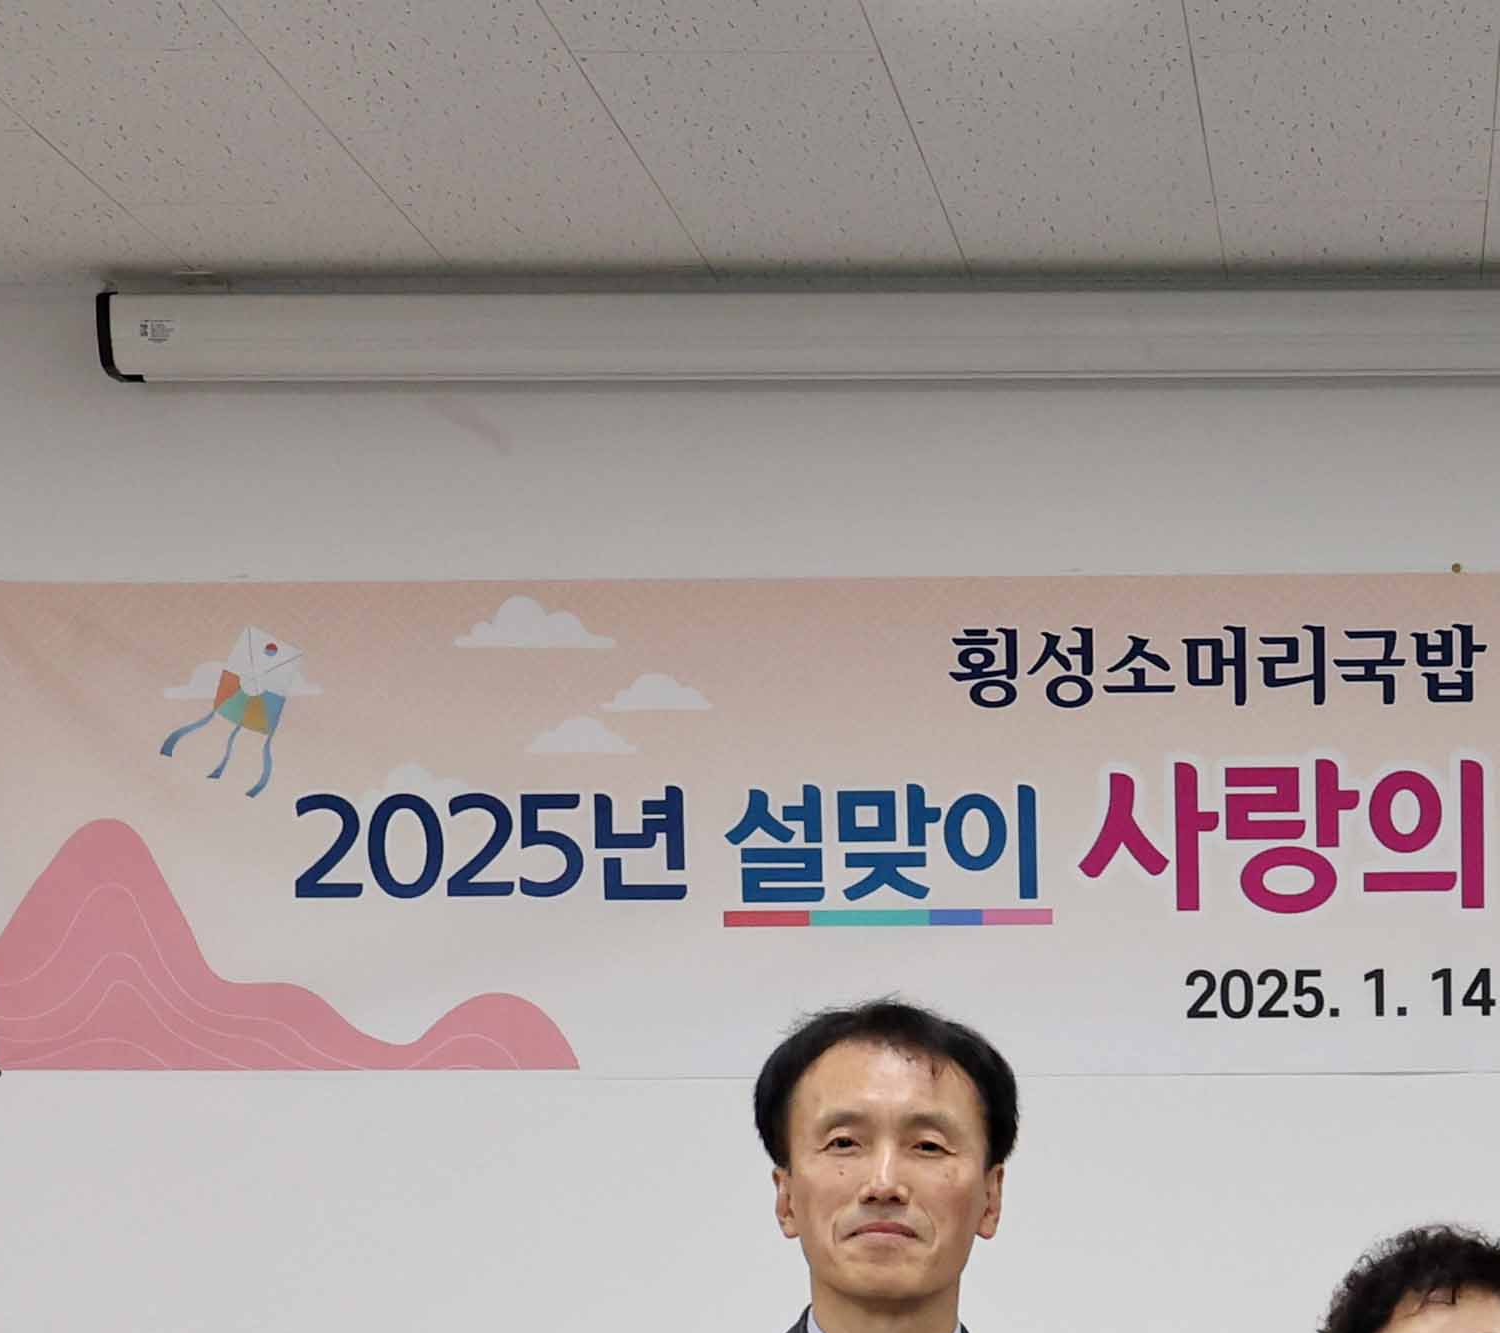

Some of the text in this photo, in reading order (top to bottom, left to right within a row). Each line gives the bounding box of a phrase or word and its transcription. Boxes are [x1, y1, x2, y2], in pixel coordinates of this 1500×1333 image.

[950, 624, 1487, 709] 횡성소머리국밥
[293, 784, 687, 902] 2025년
[723, 785, 1037, 903] 설맞이
[1080, 758, 1486, 916] 사랑의
[1185, 971, 1341, 1020] 2025.
[1361, 970, 1412, 1018] 1.
